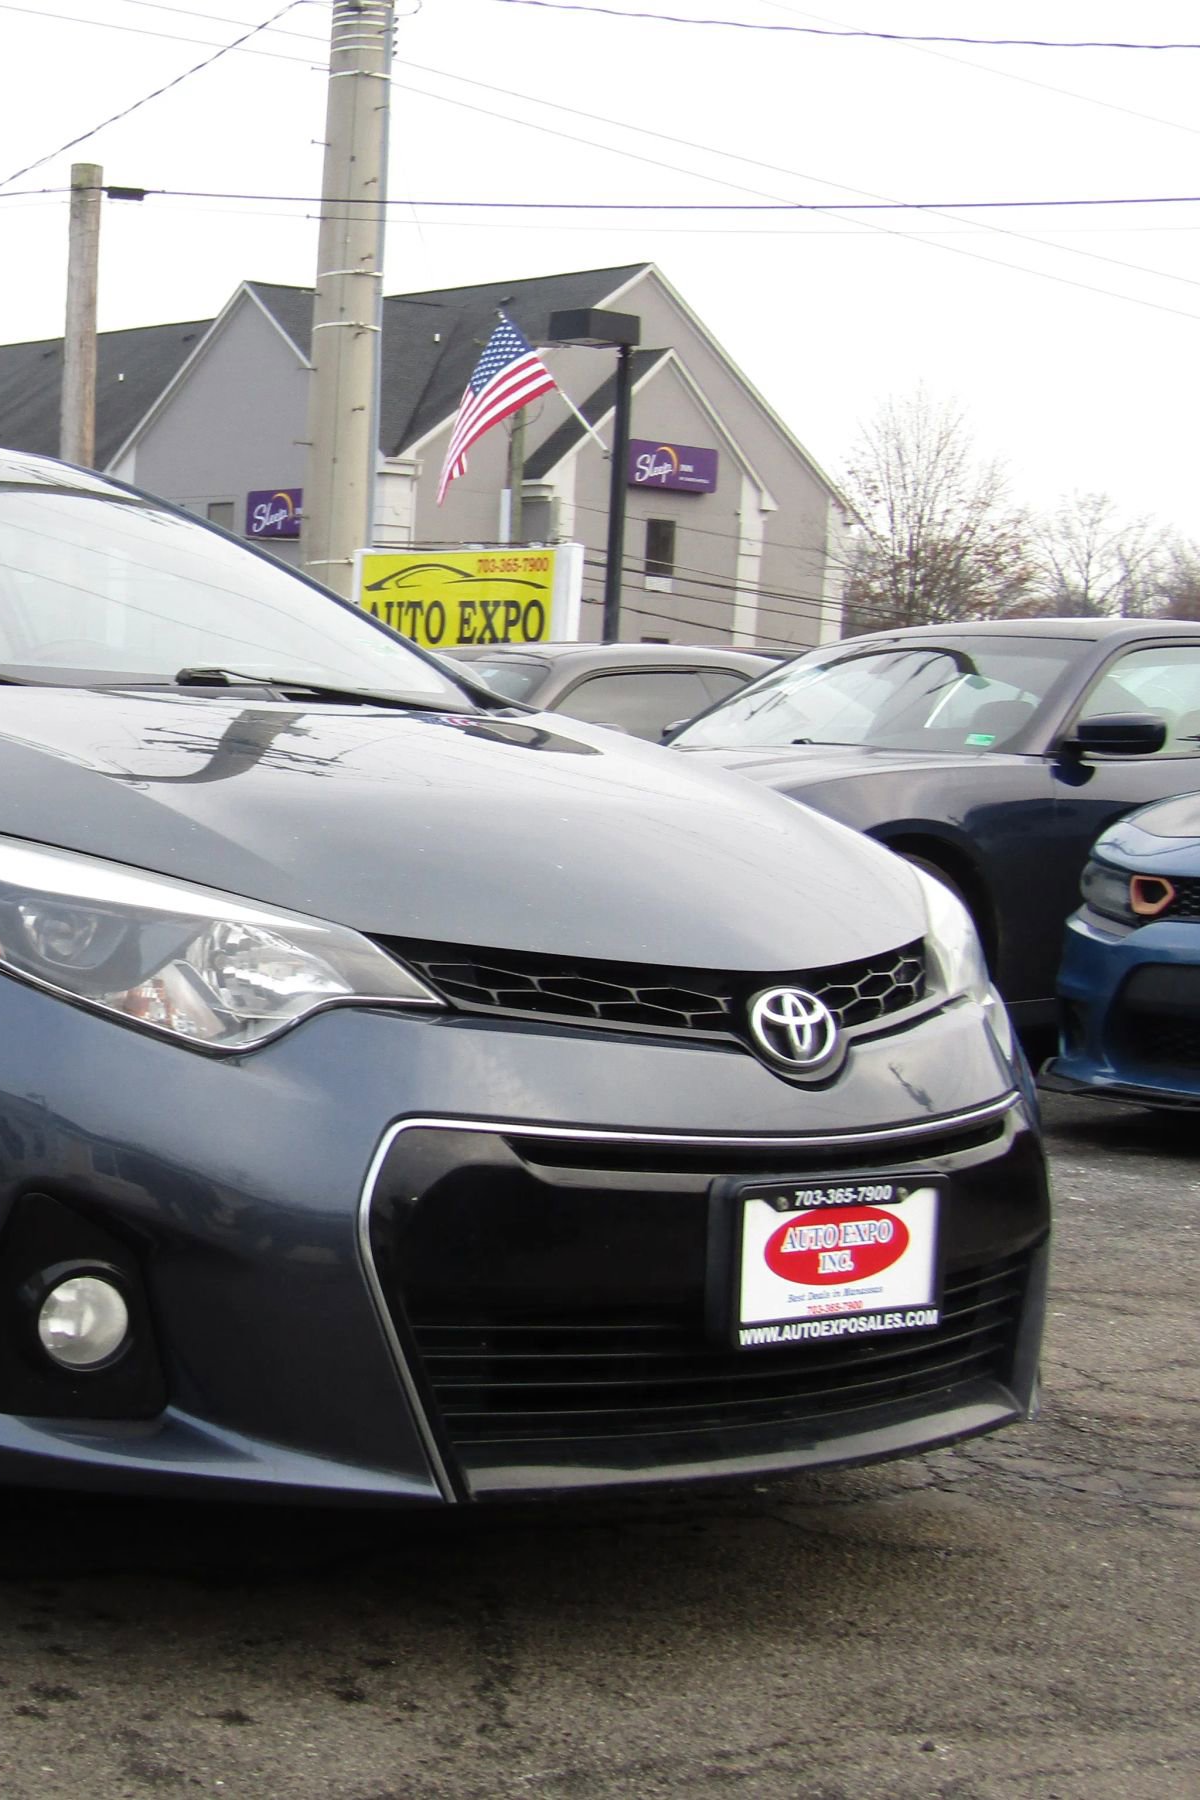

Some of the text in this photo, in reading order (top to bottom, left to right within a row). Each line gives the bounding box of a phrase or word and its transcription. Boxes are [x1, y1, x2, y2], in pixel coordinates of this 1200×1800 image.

[635, 454, 672, 483] Sleep
[252, 503, 289, 533] Sleep
[477, 557, 549, 574] 703-365-7900
[456, 599, 546, 645] EXPO
[794, 1185, 893, 1207] 703-365-7900
[782, 1219, 893, 1251] AUTO EXPO
[818, 1250, 854, 1273] INC.
[739, 1309, 939, 1346] WWW.AUTOEXPOSALES.COM
